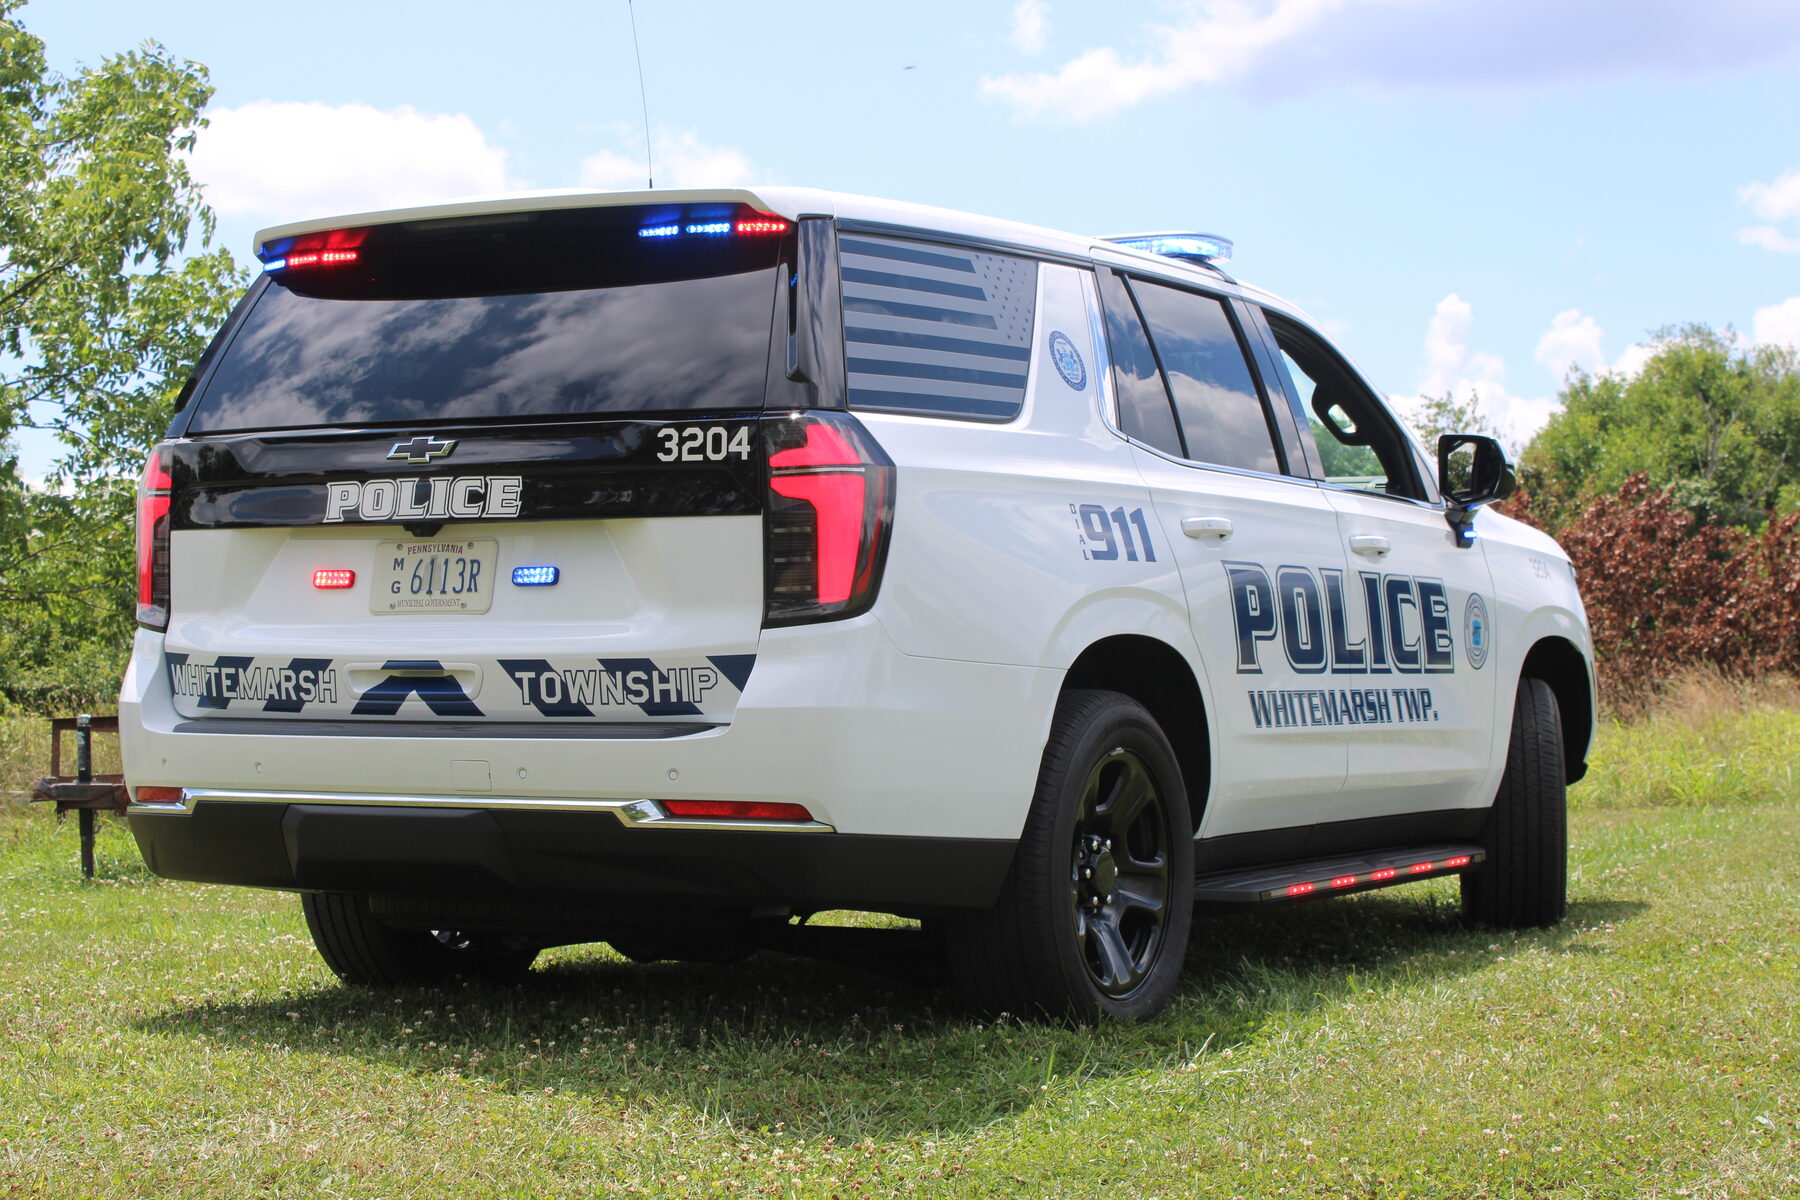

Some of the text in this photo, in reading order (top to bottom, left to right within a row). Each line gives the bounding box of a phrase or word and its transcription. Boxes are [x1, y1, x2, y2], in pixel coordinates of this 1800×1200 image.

[657, 426, 750, 462] 3204
[322, 476, 523, 523] POLICE
[407, 543, 464, 555] PENNSYLVANIA
[1068, 503, 1090, 561] DIAL
[1079, 504, 1157, 562] 911
[410, 557, 481, 595] 6113R
[425, 598, 461, 607] GOVERNMENT
[1220, 560, 1455, 674] POLICE
[171, 663, 718, 706] WHITEMARSH TOWNSHIP
[1248, 688, 1439, 728] WHITEMARSH TWP.
